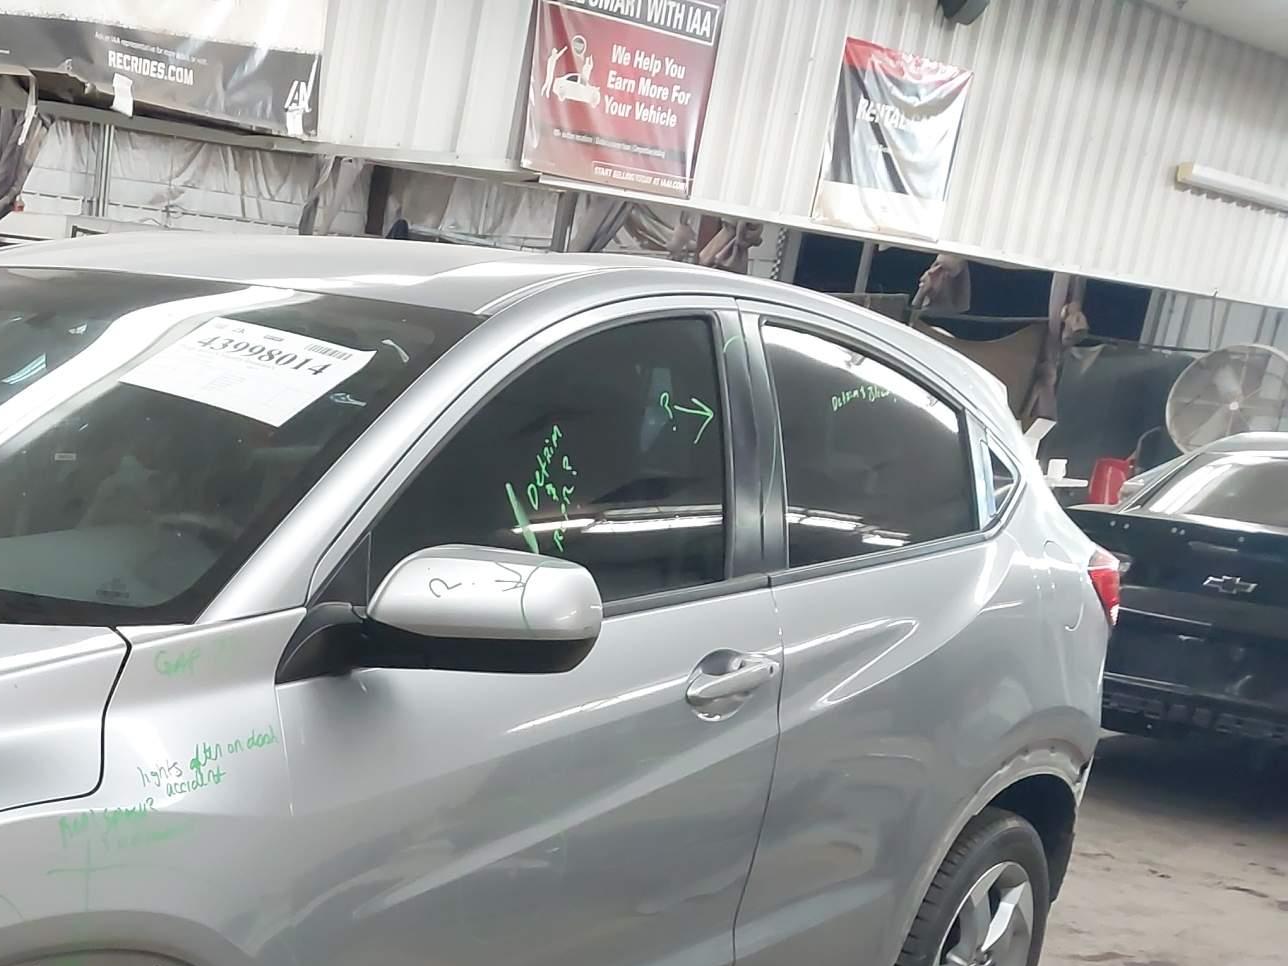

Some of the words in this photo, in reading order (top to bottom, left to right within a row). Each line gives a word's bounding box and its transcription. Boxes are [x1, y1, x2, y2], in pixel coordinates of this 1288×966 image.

[647, 0, 686, 30] WITH
[686, 8, 711, 37] IAA
[108, 50, 194, 86] RECRIDES.COM
[611, 44, 631, 64] We
[633, 50, 662, 77] Help
[664, 57, 686, 79] You
[607, 70, 636, 94] Earn
[638, 76, 669, 100] More
[670, 85, 692, 106] For
[603, 95, 632, 119] Your
[634, 101, 678, 128] Vehicle
[197, 335, 332, 376] 43998014
